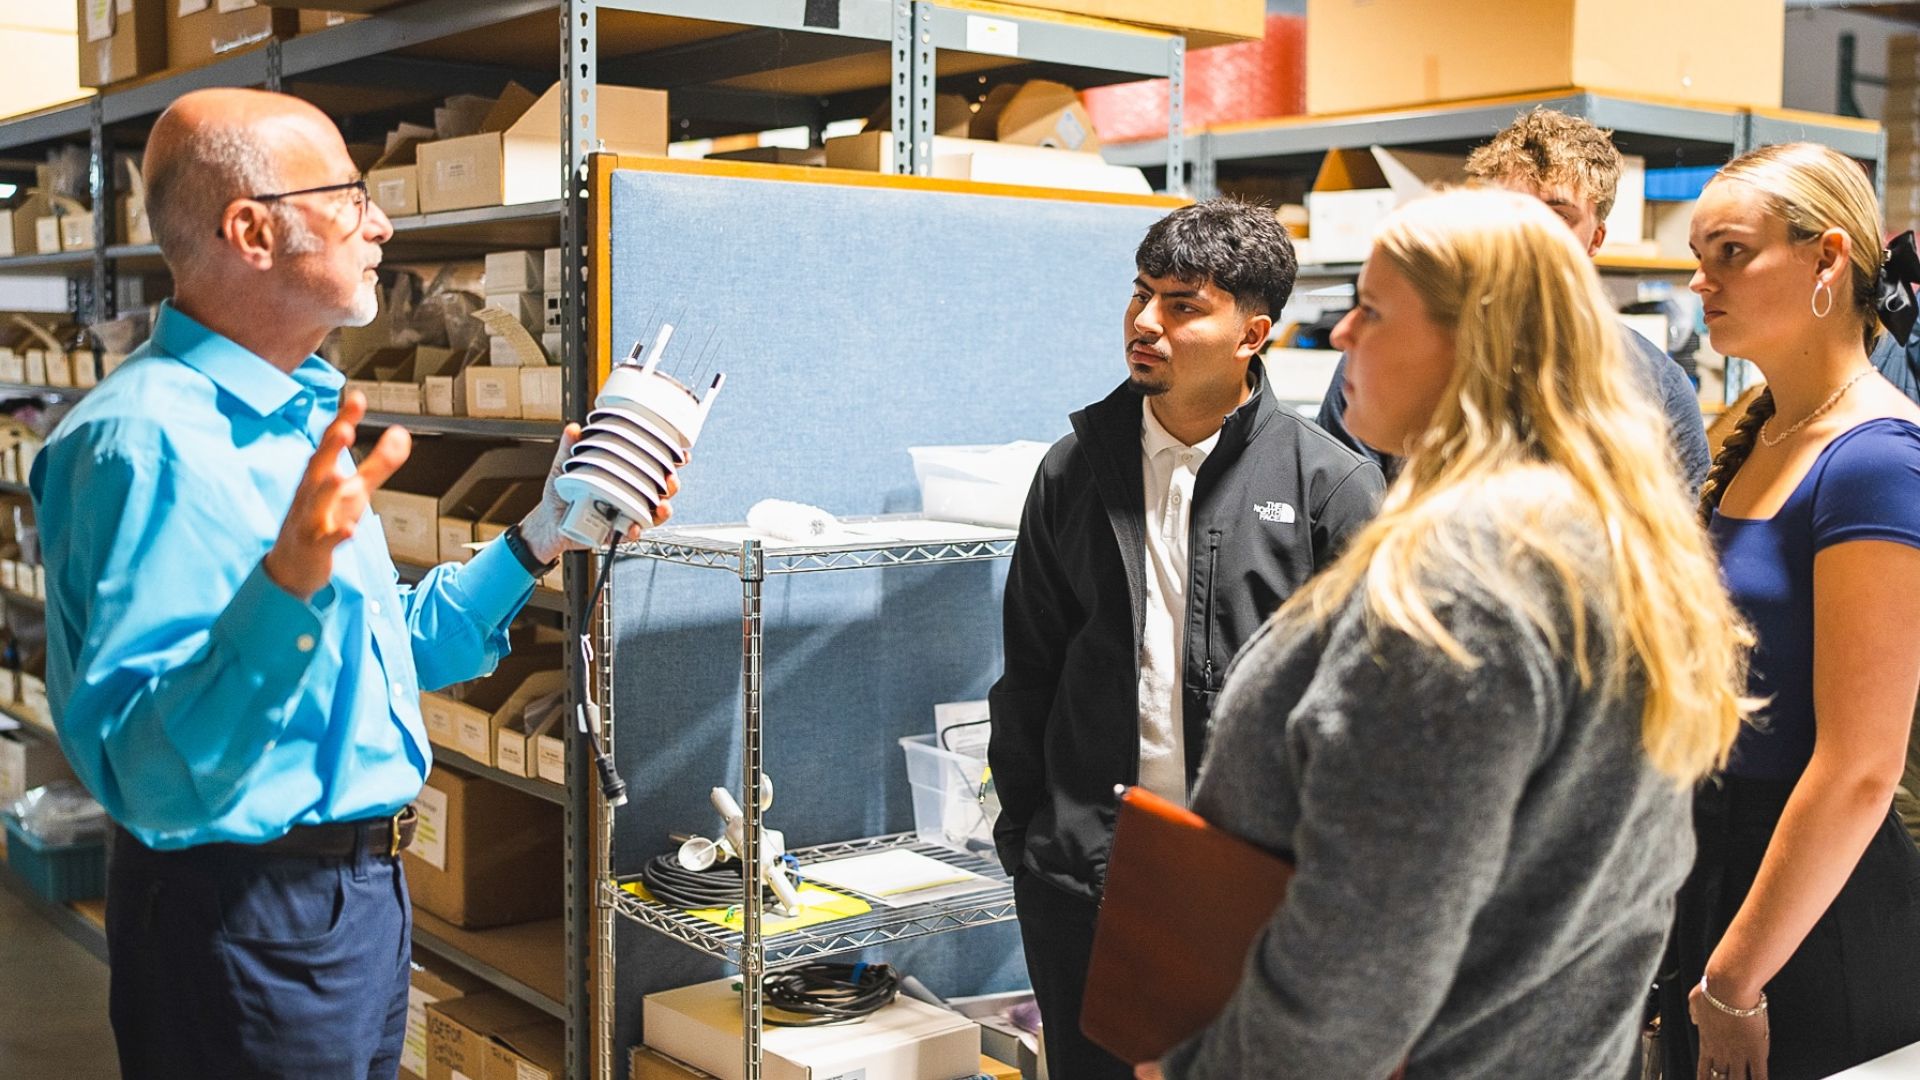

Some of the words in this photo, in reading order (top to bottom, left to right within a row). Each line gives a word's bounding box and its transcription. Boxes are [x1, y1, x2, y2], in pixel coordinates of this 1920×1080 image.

[1253, 504, 1281, 516] NORTH
[1266, 501, 1282, 510] THE
[1259, 512, 1281, 522] FACE
